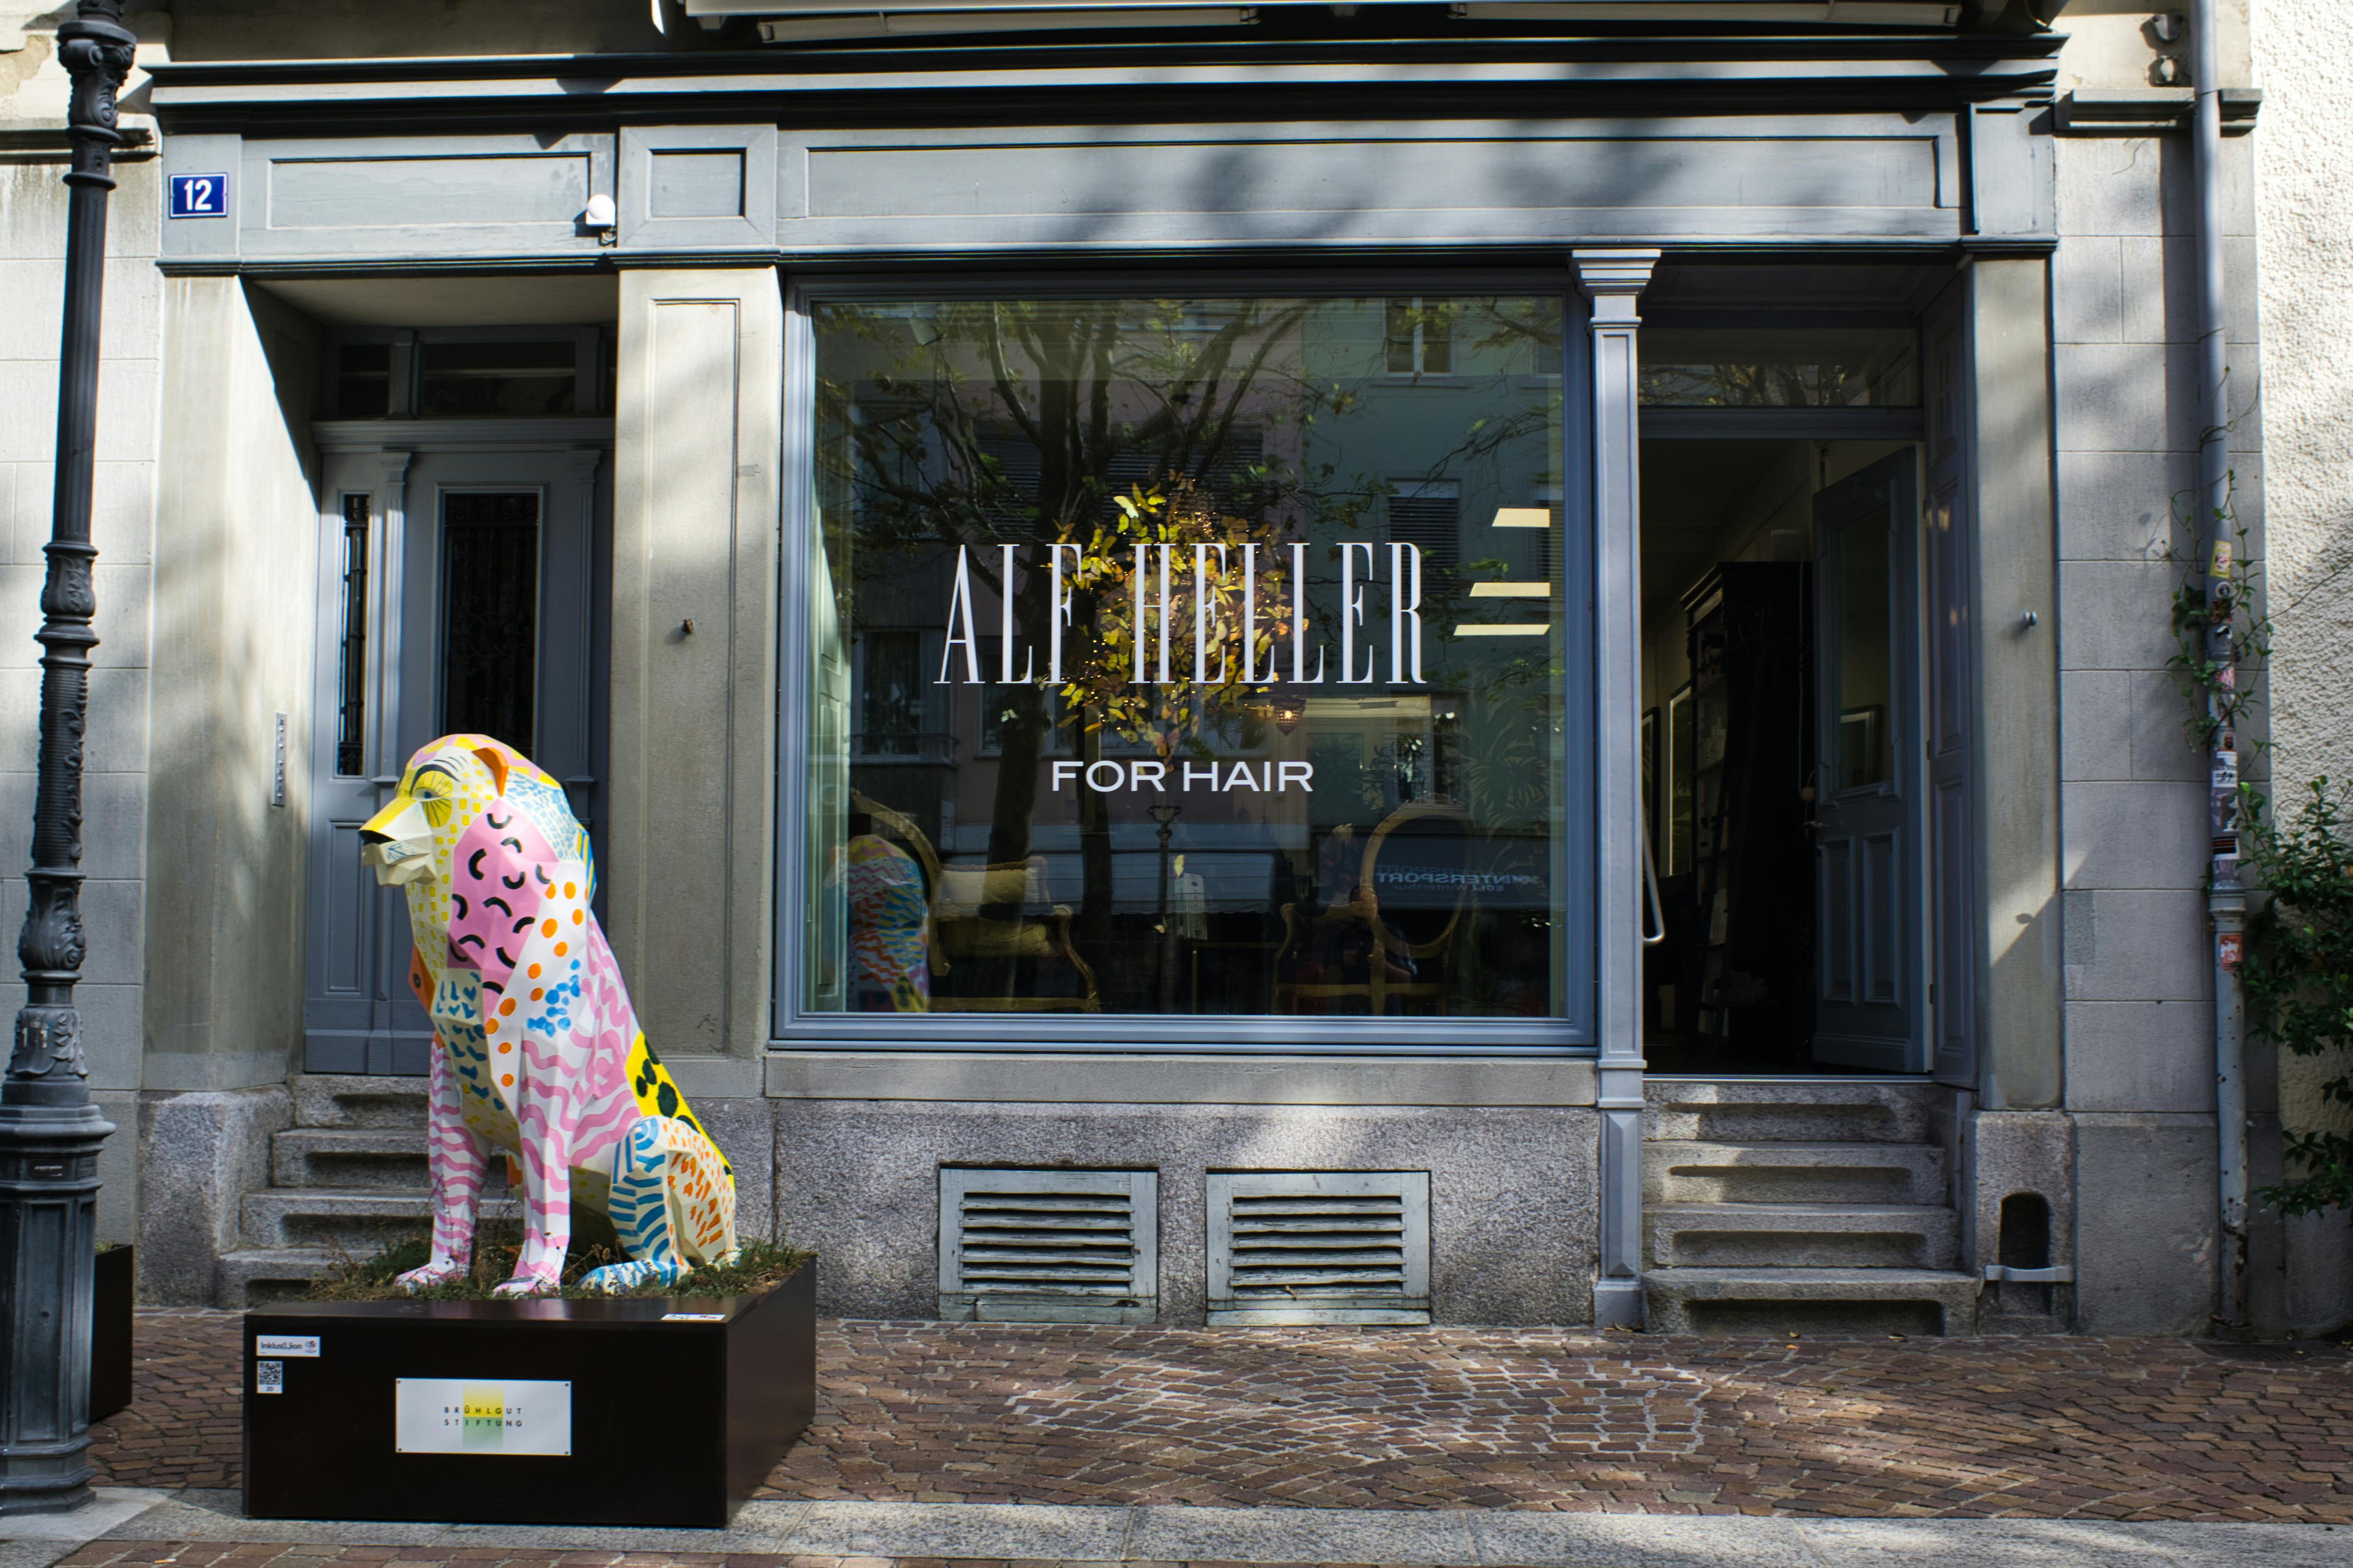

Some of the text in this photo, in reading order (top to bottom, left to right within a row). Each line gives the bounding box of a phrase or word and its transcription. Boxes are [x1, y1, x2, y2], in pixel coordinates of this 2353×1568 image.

[184, 179, 212, 210] 12
[933, 543, 1427, 684] ALF HELLER
[1051, 761, 1314, 792] FOR HAIR
[444, 1405, 522, 1414] BRÜHLGUT
[444, 1419, 523, 1427] STIFTUNG
